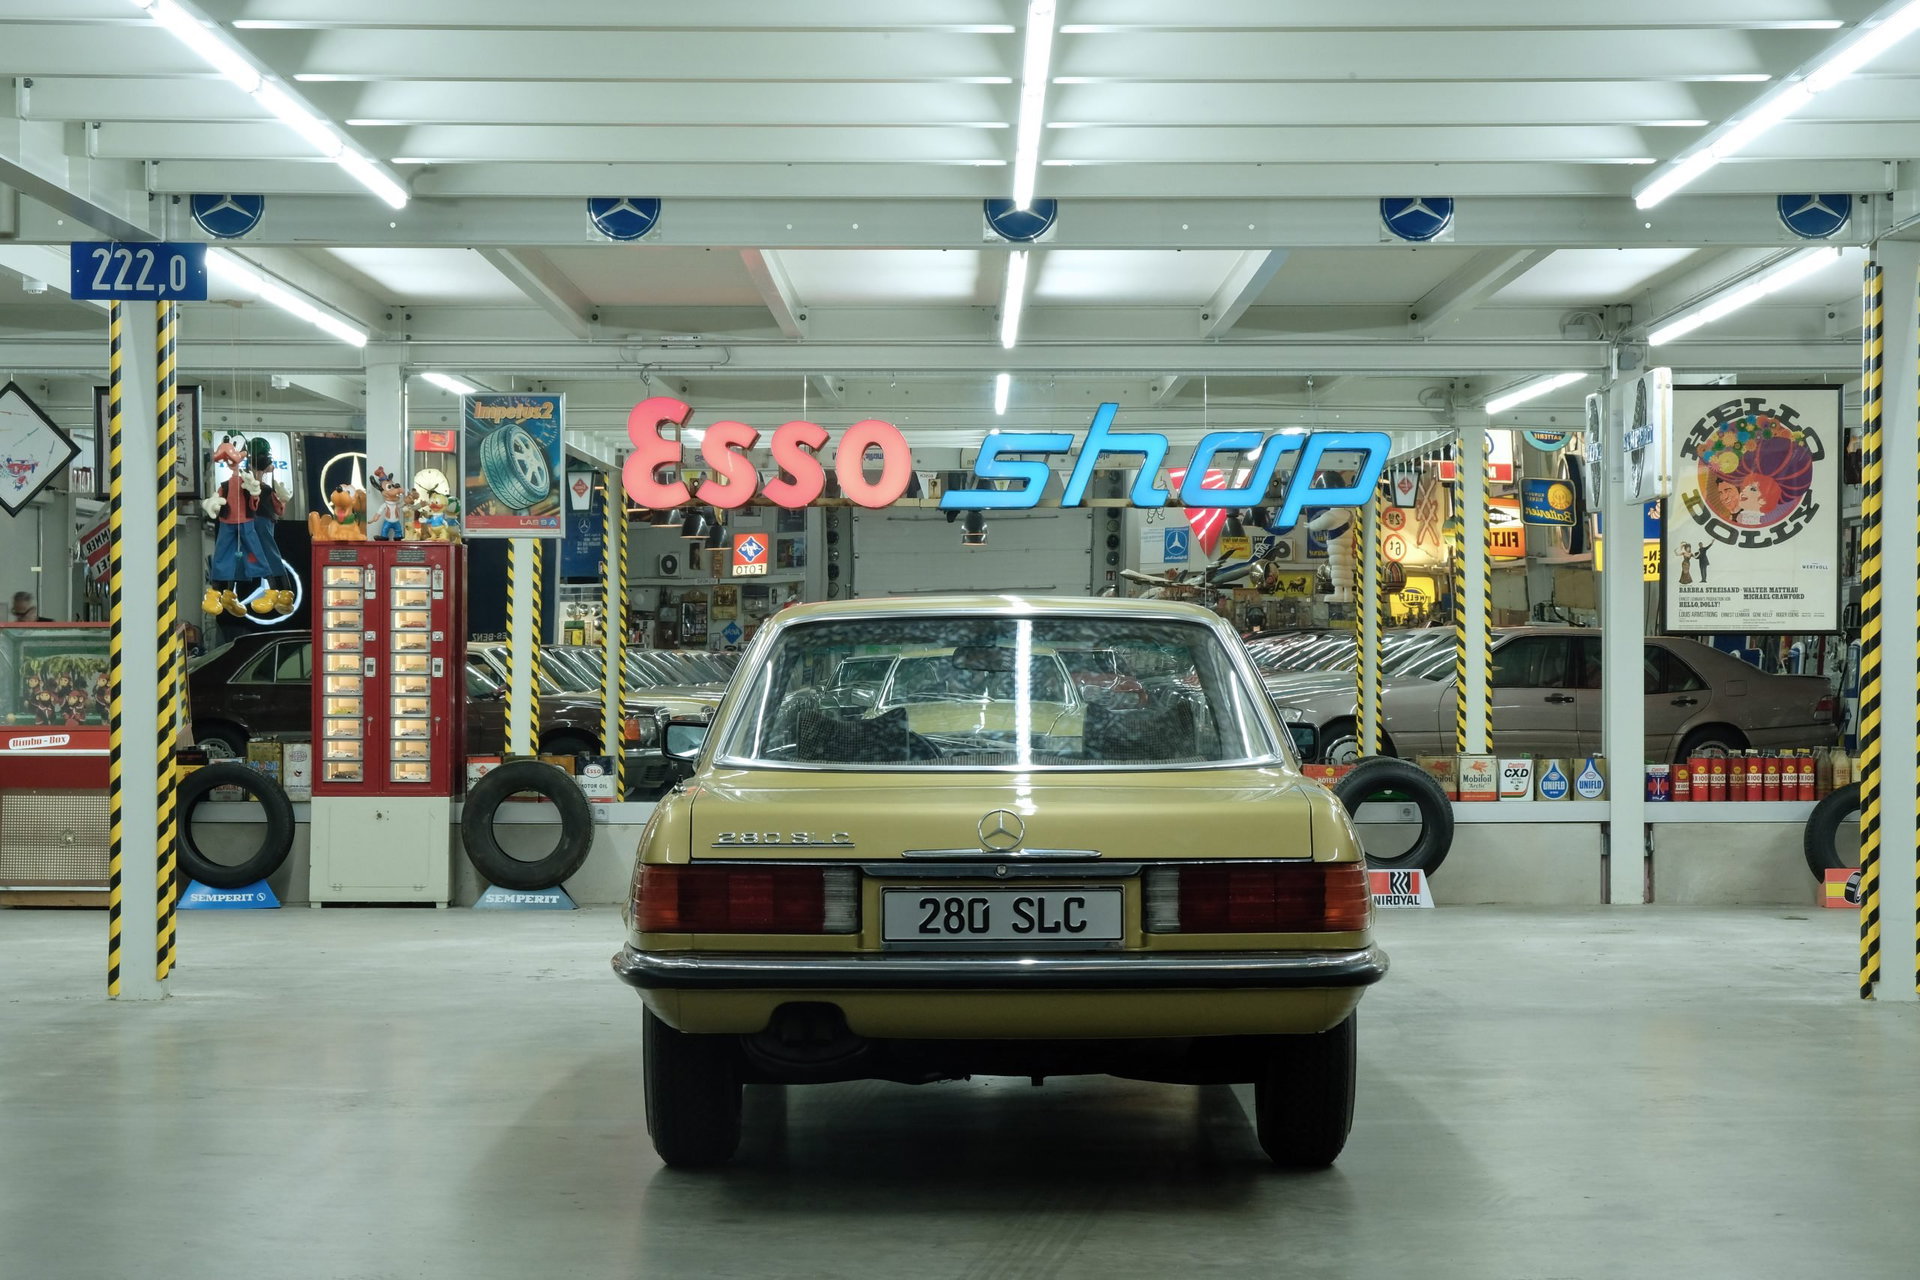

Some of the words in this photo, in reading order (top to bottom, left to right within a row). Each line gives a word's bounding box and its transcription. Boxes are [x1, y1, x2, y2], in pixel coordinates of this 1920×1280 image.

[92, 248, 186, 296] 222,0
[1680, 398, 1825, 461] HELLO
[939, 403, 1391, 528] shop
[1681, 489, 1820, 549] DOLLY
[1463, 774, 1492, 783] Mobiloil
[1504, 769, 1529, 777] CXD
[1542, 781, 1566, 790] UNIFLO
[1579, 780, 1602, 790] UNIFLO
[718, 832, 781, 843] 280
[791, 832, 849, 843] SLC
[190, 893, 254, 902] SEMPERIT
[485, 894, 560, 904] SEMPERIT
[1373, 895, 1420, 906] NIROYAL
[918, 897, 990, 934] 280
[1011, 897, 1087, 934] SLC
